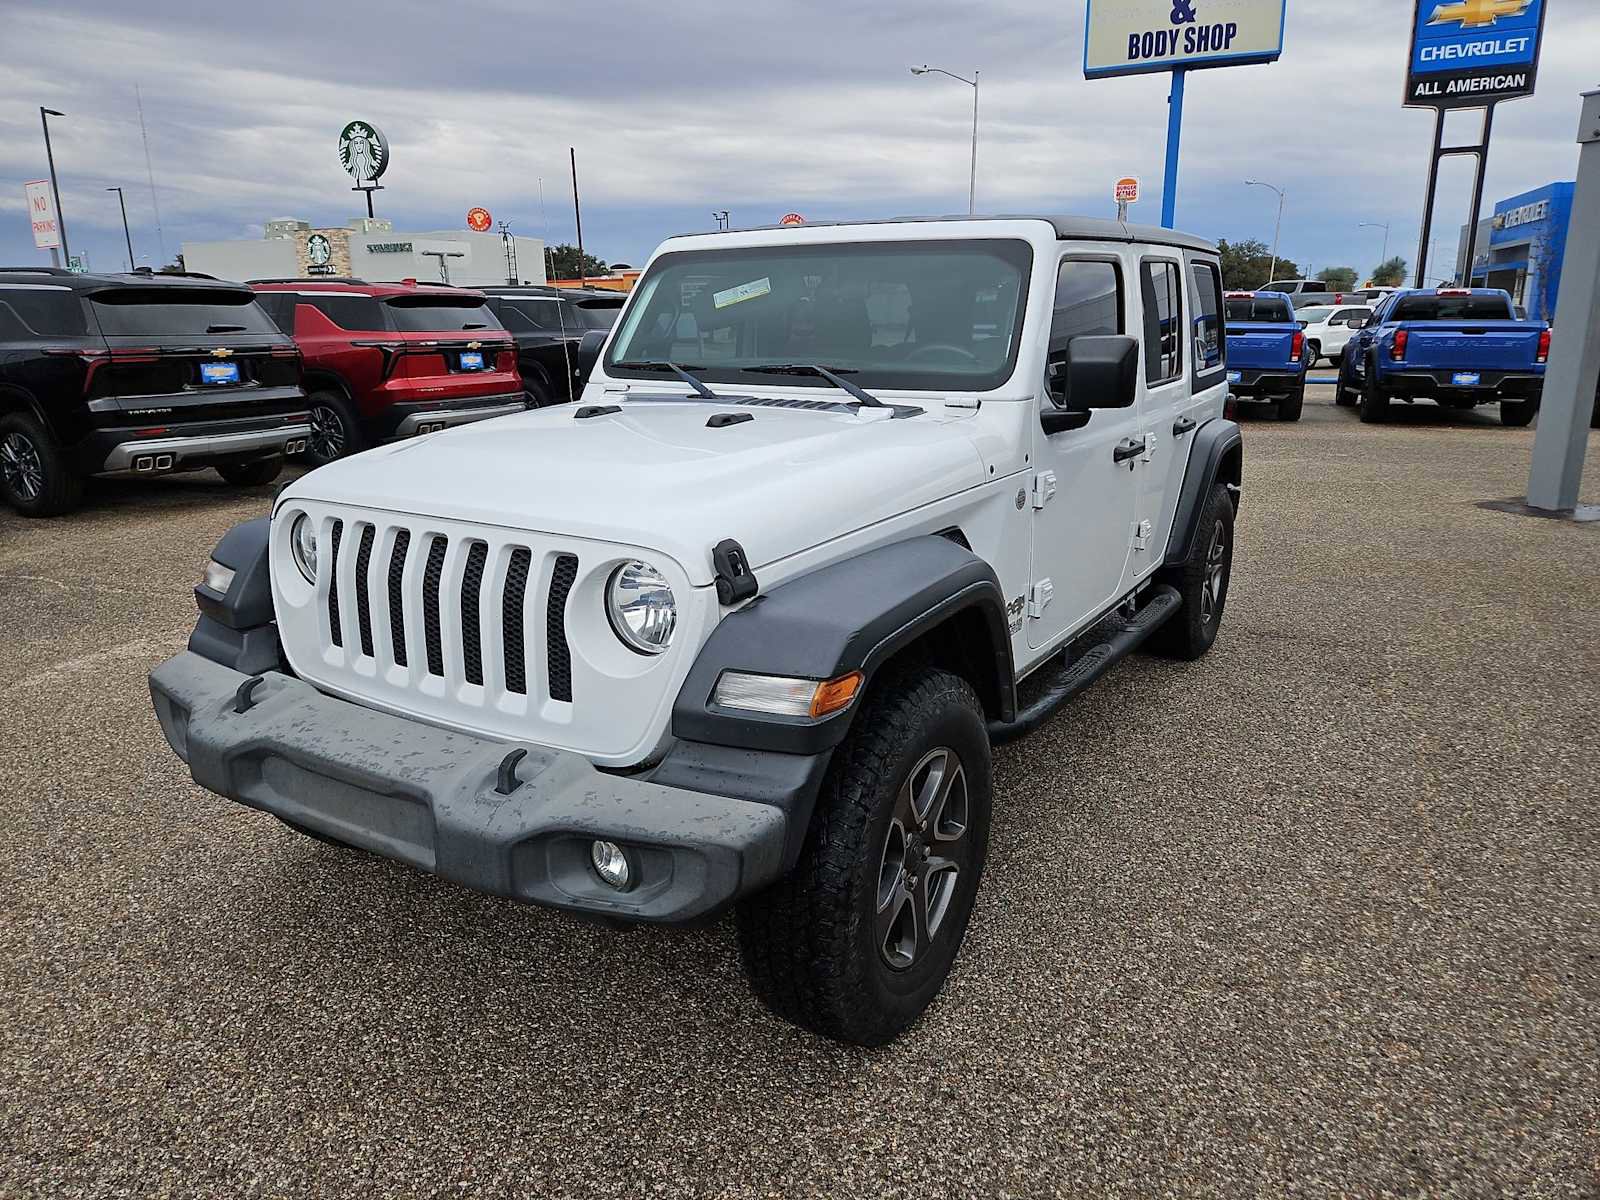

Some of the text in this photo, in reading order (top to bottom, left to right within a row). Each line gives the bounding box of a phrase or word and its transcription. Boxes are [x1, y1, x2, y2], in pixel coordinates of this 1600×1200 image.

[1170, 0, 1196, 25] &
[1128, 22, 1237, 60] BODY SHOP
[1420, 37, 1529, 62] CHEVROLET
[1415, 73, 1526, 96] ALL AMERICAN
[33, 196, 47, 212] NO
[1505, 199, 1550, 229] CHEVROLET
[32, 220, 56, 233] PARKING
[1421, 340, 1527, 348] CHEVROLET
